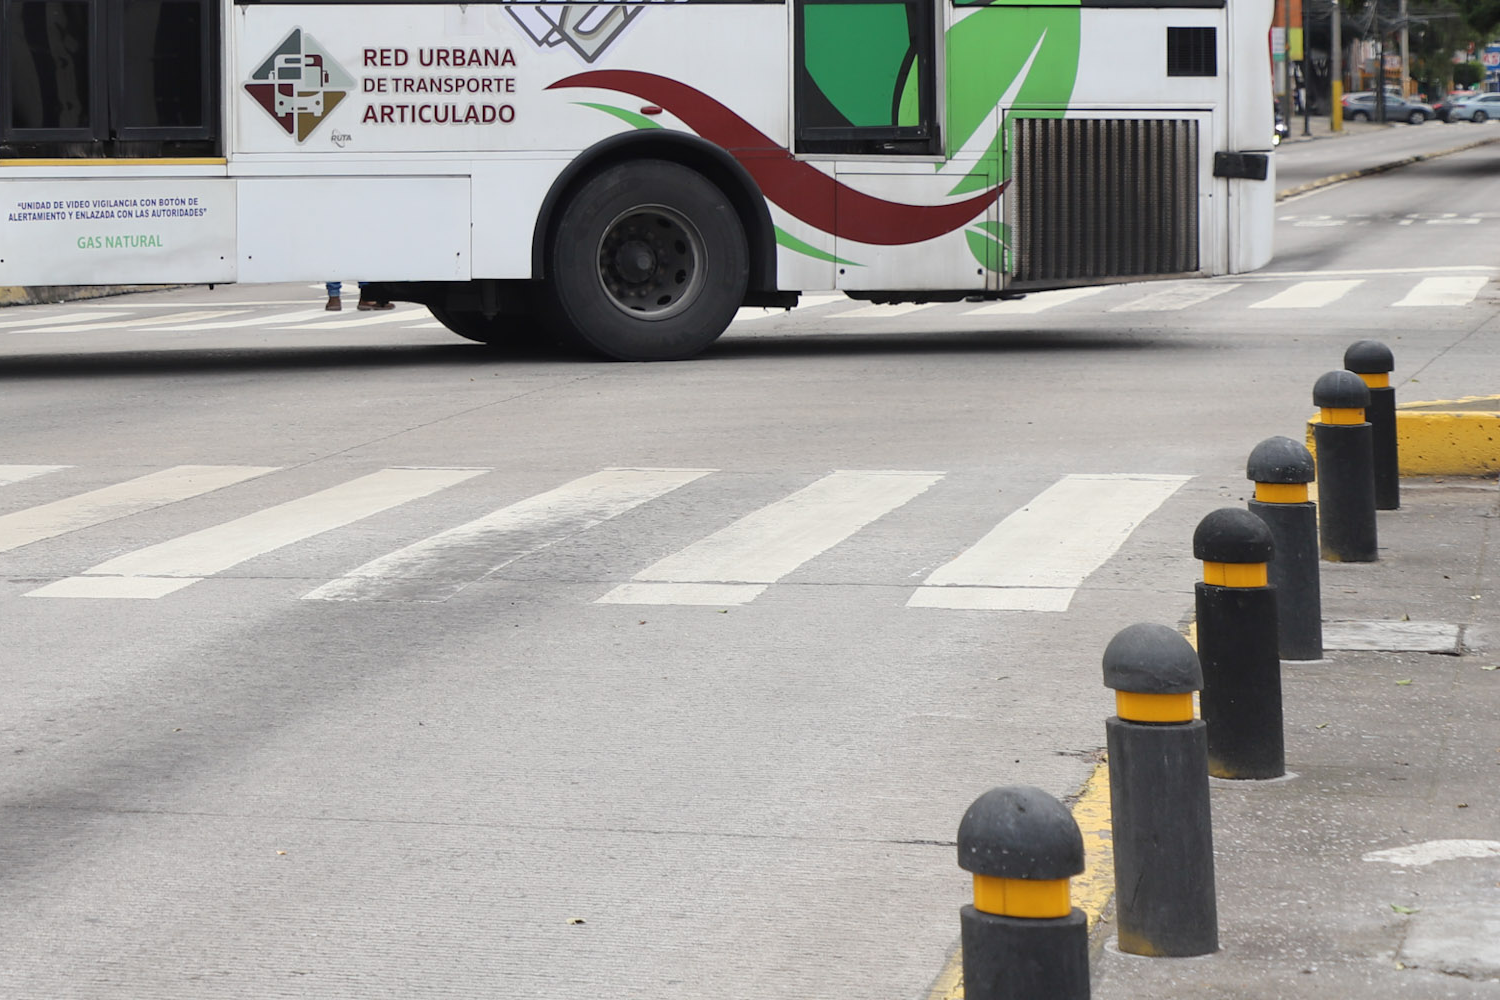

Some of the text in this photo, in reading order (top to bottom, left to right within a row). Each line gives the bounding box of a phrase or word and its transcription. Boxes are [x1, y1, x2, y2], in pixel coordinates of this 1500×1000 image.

[364, 49, 516, 67] RED URBANA
[364, 78, 516, 93] DE TRANSPORTE
[362, 104, 516, 123] ARTICULADO
[331, 134, 352, 142] RUTA
[54, 201, 64, 209] DE
[66, 200, 90, 208] VIDEO
[92, 199, 137, 208] VIGILANCIA
[140, 199, 156, 207] CON
[159, 196, 186, 206] BOTÓN
[188, 197, 198, 205] DE
[8, 211, 66, 221] ALERTAMIENTO
[69, 211, 73, 219] Y
[75, 210, 115, 219] ENLAZADA
[117, 209, 133, 218] CON
[135, 209, 150, 218] LAS
[77, 234, 163, 249] GAS NATURAL
